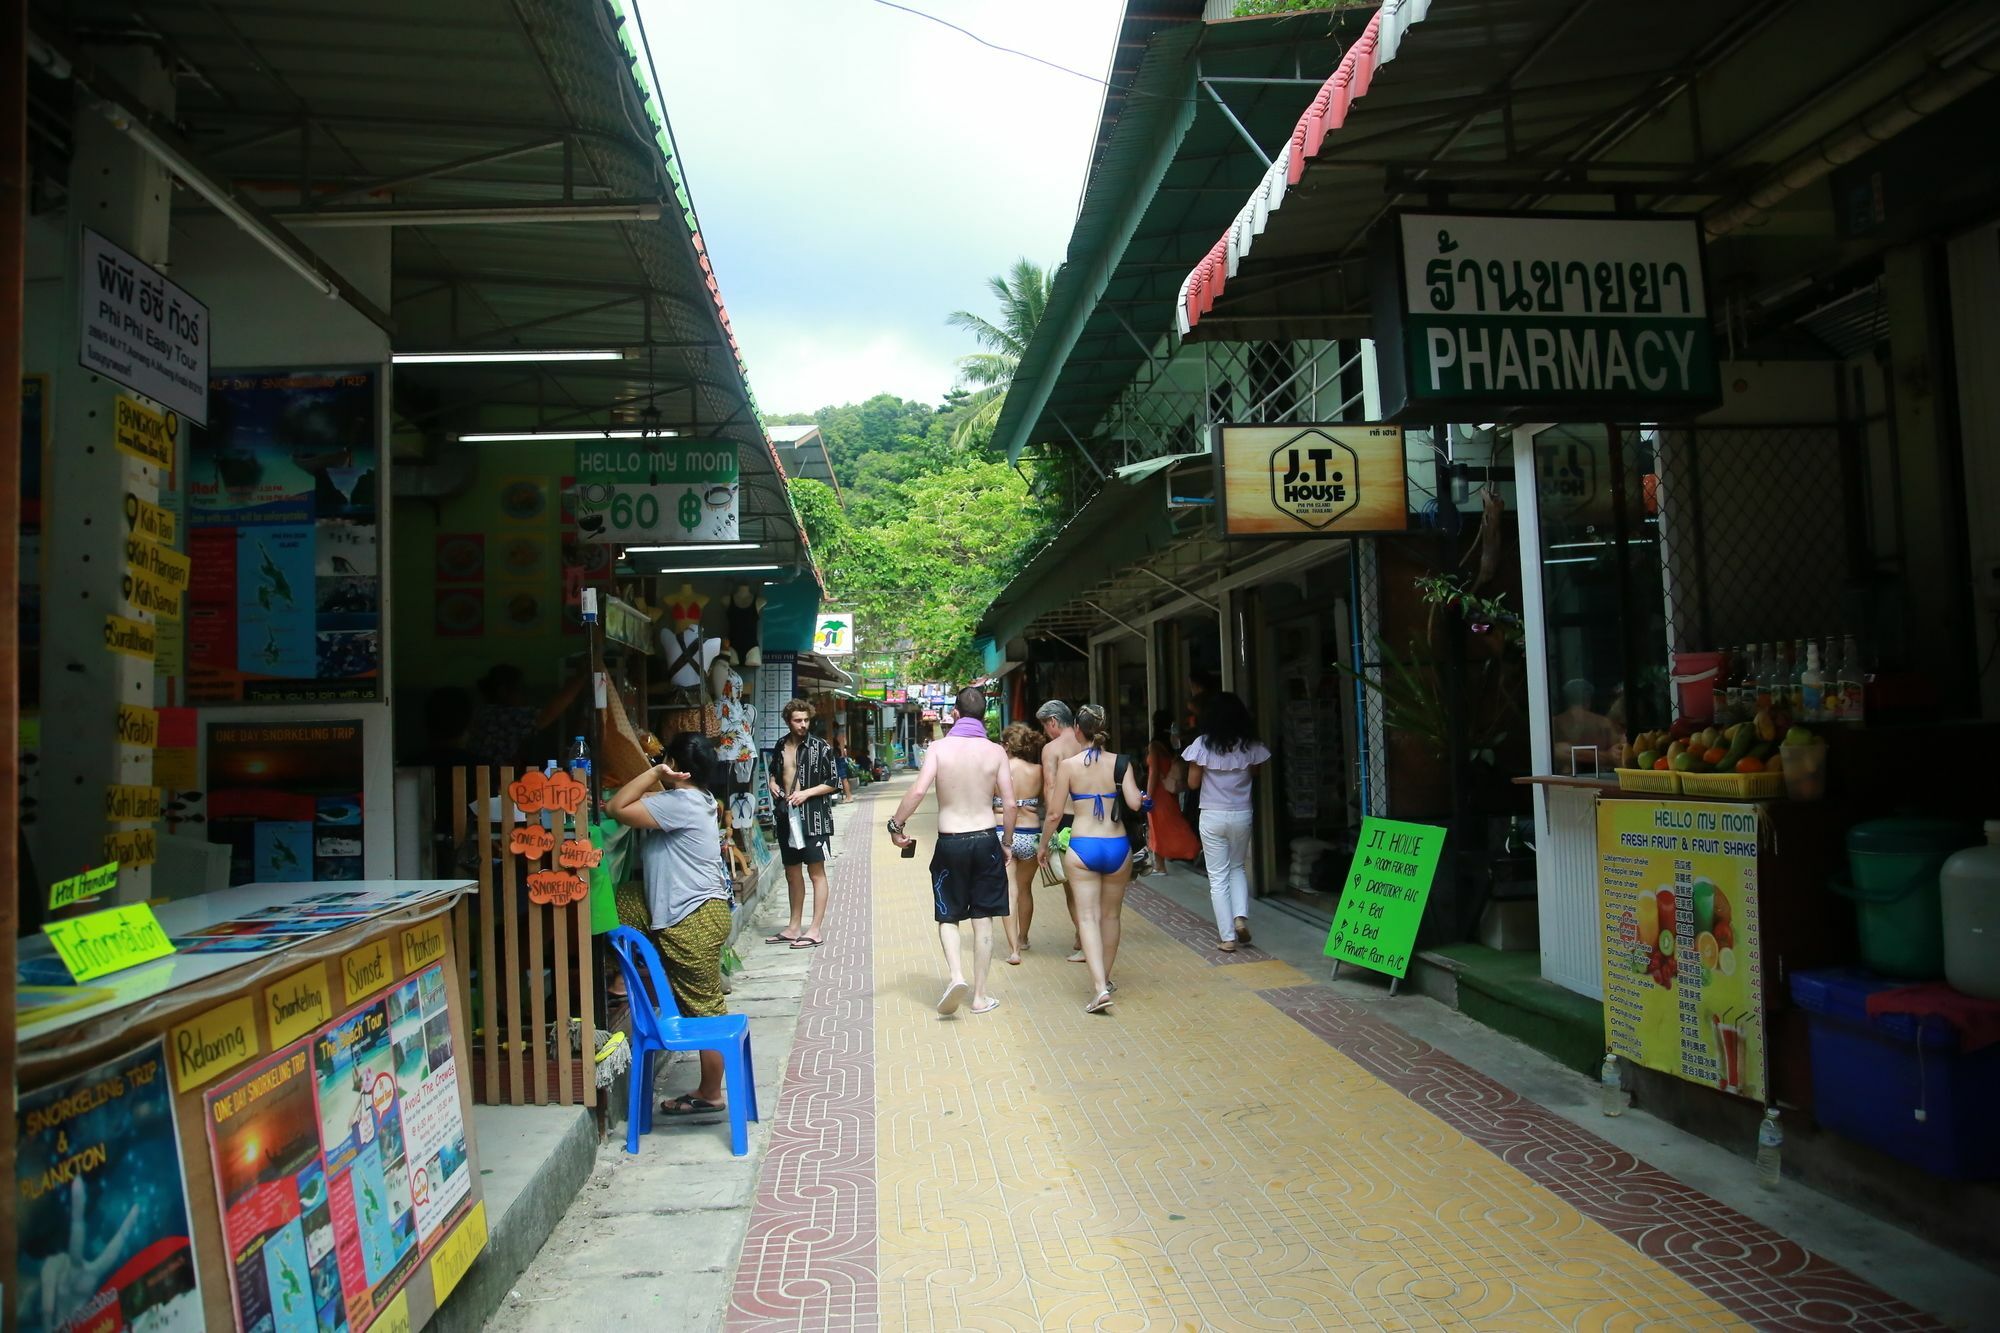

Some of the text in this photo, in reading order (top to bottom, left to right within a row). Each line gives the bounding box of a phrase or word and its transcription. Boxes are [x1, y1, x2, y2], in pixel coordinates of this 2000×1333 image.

[1426, 230, 1690, 313] ร้านขายยา
[99, 300, 198, 372] Phi Phi Easy Tour
[1426, 327, 1696, 392] PHARMACY
[209, 375, 368, 391] ALF DAY TRIP
[119, 400, 164, 443] BANGKOK
[581, 452, 641, 472] HELLO
[1283, 449, 1343, 485] J.T.
[1284, 485, 1346, 502] HOUSE
[141, 504, 156, 534] Koh
[157, 512, 173, 541] Tao
[611, 492, 659, 530] 60
[134, 576, 178, 616] Koh Samui
[359, 690, 375, 699] us
[122, 711, 153, 743] Krabi
[216, 727, 356, 743] ONE DAY SNORKELING TRIP
[545, 784, 581, 811] Trip
[1655, 810, 1692, 828] HELLO
[516, 832, 554, 849] ONE DAY
[564, 847, 586, 861] HAFT
[1388, 833, 1424, 857] HOUSE
[1620, 833, 1757, 857] FRESH FRUIT & FRUIT SHAKE
[1375, 857, 1392, 872] ROOM
[1392, 860, 1404, 875] FOR
[55, 883, 75, 904] Hot
[532, 880, 582, 897] SNORELING
[551, 892, 571, 905] TRIP
[1404, 888, 1420, 903] A/C
[1358, 901, 1385, 919] 4 Bed
[49, 911, 156, 976] Information
[1362, 923, 1380, 940] Bed
[405, 931, 442, 968] Plankton
[1343, 940, 1369, 960] Private
[1387, 954, 1405, 971] A/C
[349, 952, 385, 997] Sunset
[272, 983, 323, 1026] Snorkeling
[320, 1039, 337, 1061] The
[365, 1012, 384, 1031] Tour
[178, 1029, 246, 1077] Relaxing
[26, 1059, 158, 1137] SNORKELING TRIP
[213, 1051, 306, 1123] ONE DAY SNORKELING TRIP
[405, 1089, 420, 1113] Avoid
[422, 1082, 433, 1097] The
[435, 1064, 455, 1087] Crowds
[57, 1131, 69, 1153] &
[20, 1143, 106, 1200] PLANKTON
